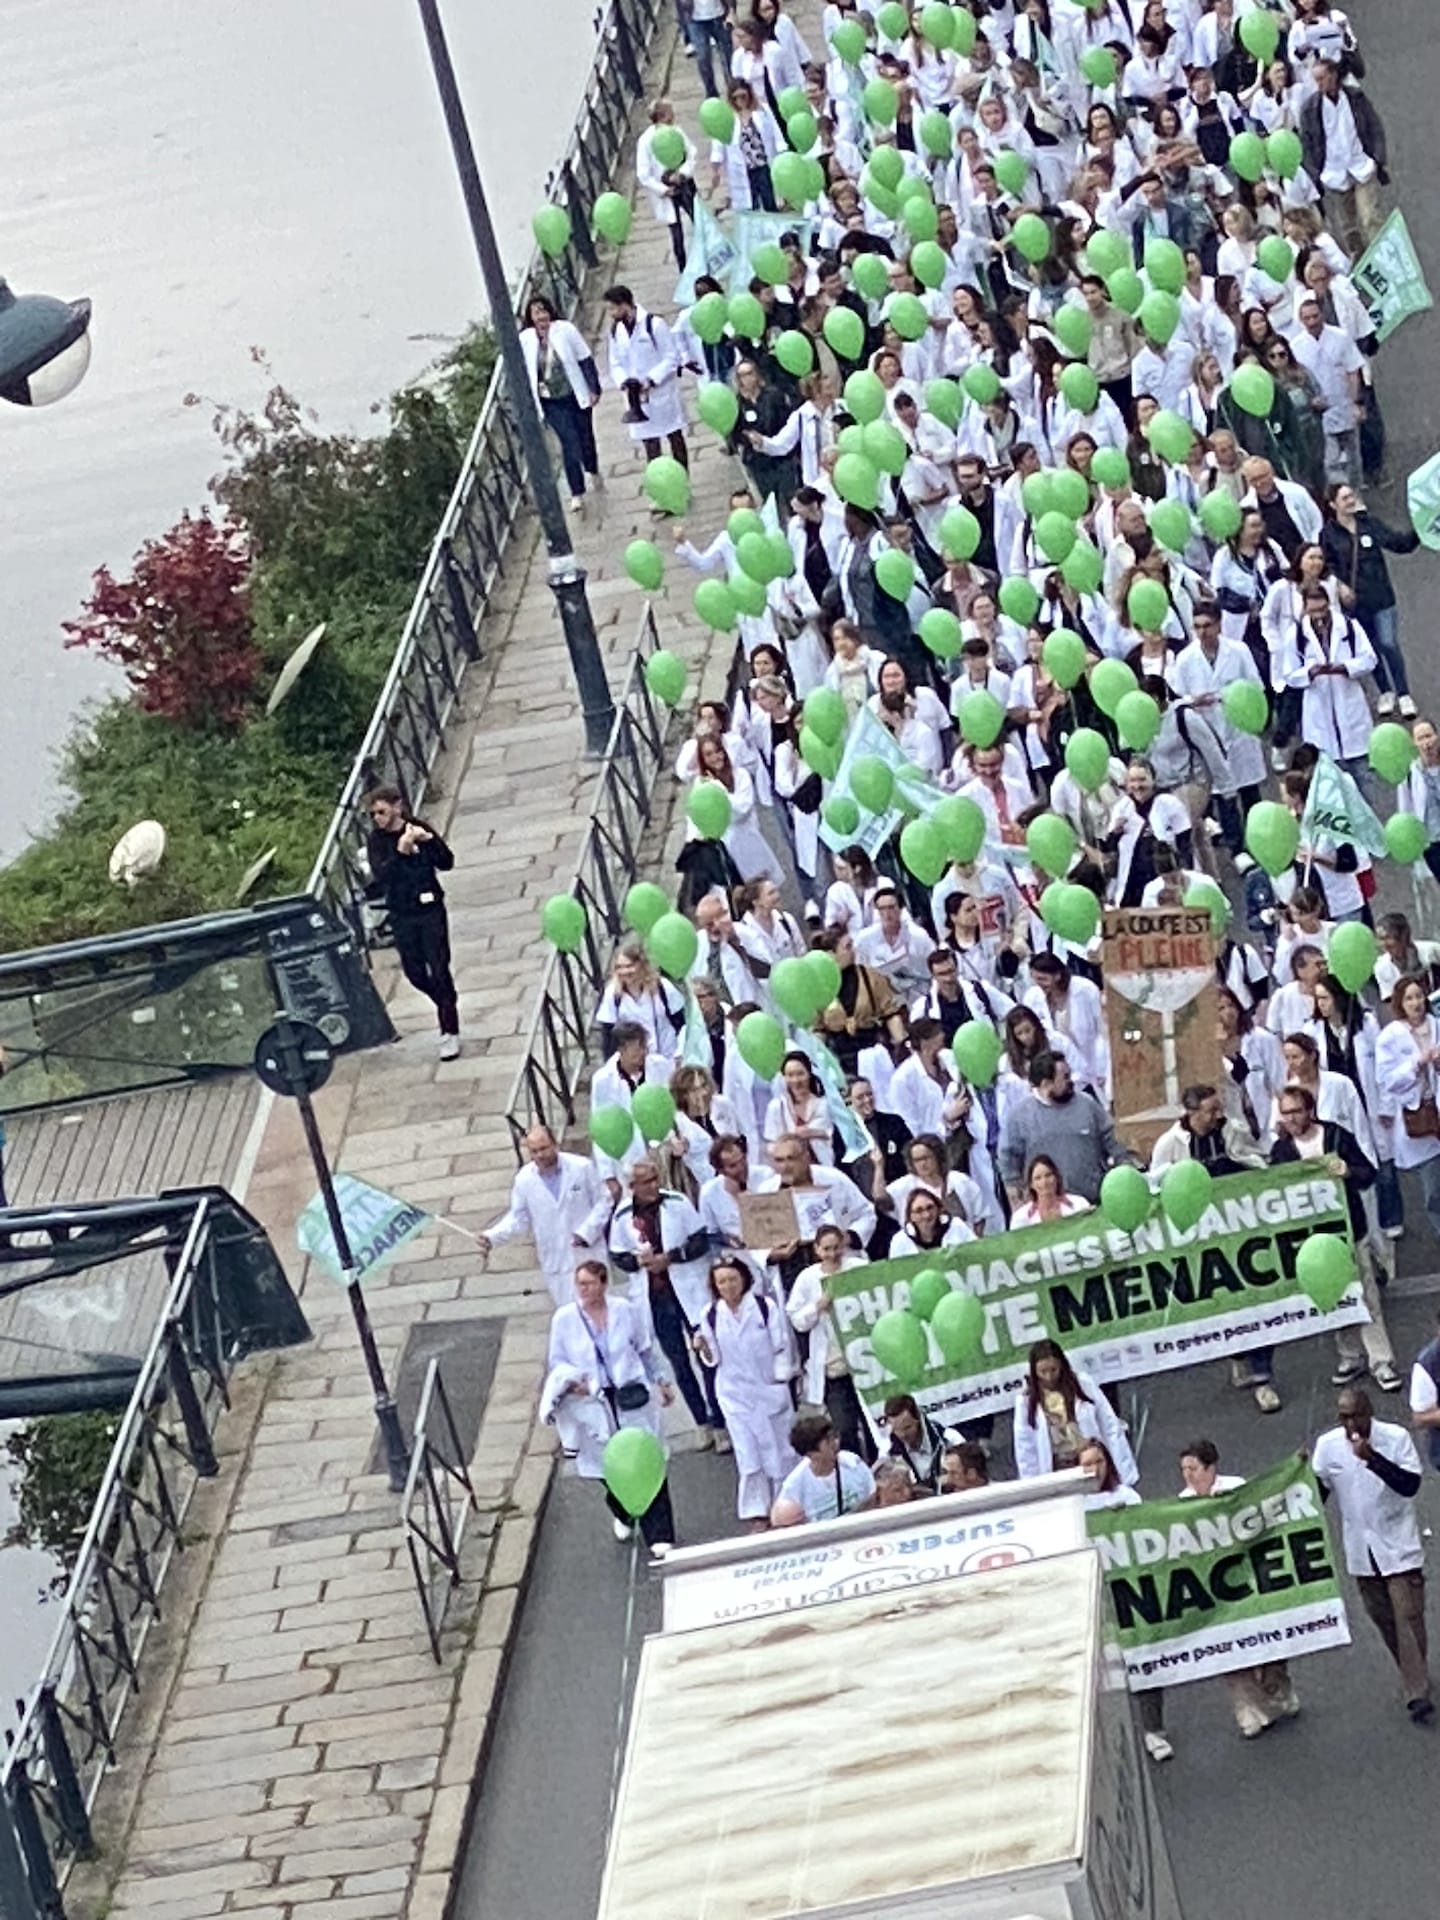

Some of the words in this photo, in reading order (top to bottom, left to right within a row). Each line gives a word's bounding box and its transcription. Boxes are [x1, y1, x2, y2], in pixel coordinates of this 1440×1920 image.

[1102, 918, 1127, 941] LA
[1129, 914, 1182, 935] COUPE
[833, 1234, 1105, 1333] PHAMACIES
[845, 1292, 1048, 1391] STE
[1049, 1219, 1350, 1333] MENACE
[1153, 1340, 1175, 1356] En
[1223, 1321, 1261, 1342] pour
[1262, 1308, 1306, 1330] votre
[896, 1518, 1016, 1554] SUPER
[1109, 1527, 1336, 1630] NACEE
[1127, 1664, 1140, 1677] n
[1141, 1649, 1190, 1677] grève
[1192, 1640, 1234, 1664] pour
[1236, 1628, 1283, 1651] votre
[1285, 1613, 1339, 1640] avenir
